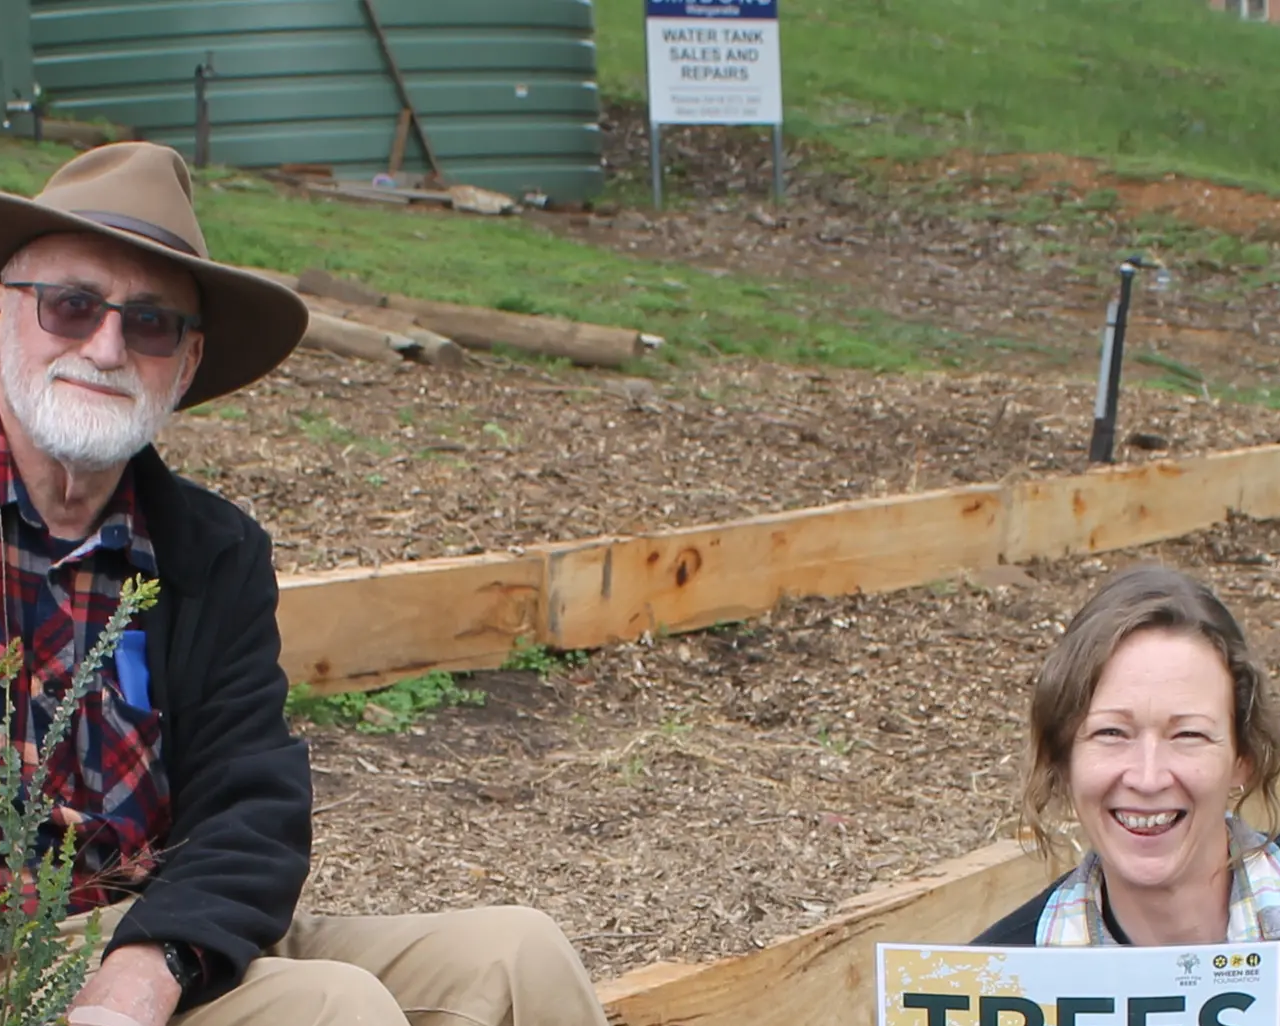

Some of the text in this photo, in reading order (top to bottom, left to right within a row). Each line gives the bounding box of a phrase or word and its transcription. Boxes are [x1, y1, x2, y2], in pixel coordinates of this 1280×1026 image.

[662, 28, 763, 44] WATER TANK
[669, 46, 760, 62] SALES AND
[681, 65, 749, 81] REPAIRS
